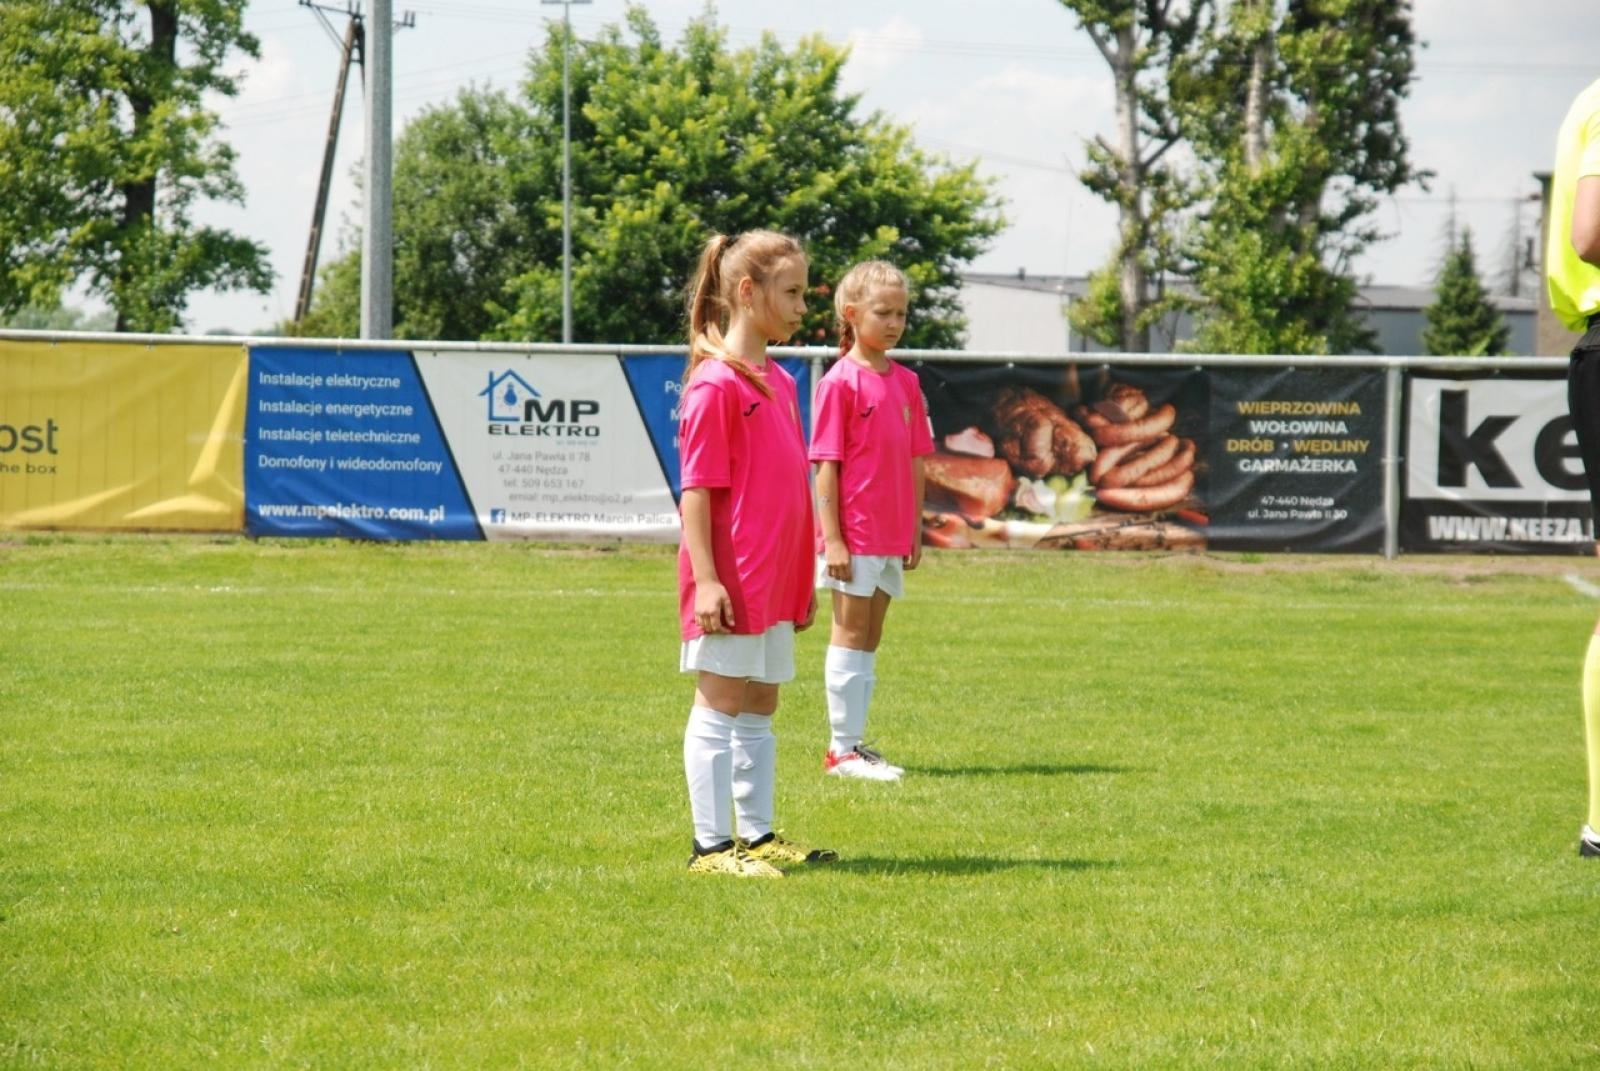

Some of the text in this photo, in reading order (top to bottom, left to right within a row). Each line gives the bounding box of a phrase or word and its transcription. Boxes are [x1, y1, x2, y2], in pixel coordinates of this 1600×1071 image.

[259, 371, 401, 390] Instalacje elektryczne
[259, 399, 413, 418] Instalacje energetyczne
[524, 399, 600, 423] MP
[1237, 401, 1361, 415] WIEPRZOWINA
[488, 424, 600, 437] ELEKTRO
[1250, 420, 1349, 434] WOŁOWINA
[259, 428, 421, 444] Instalacje teletechniczne
[1226, 436, 1370, 455] DRÓB WĘDLINY
[507, 451, 532, 461] Jana
[26, 461, 57, 474] box
[258, 454, 443, 474] Domofony i wideodomofony
[498, 464, 533, 474] 47-440
[1238, 456, 1358, 473] GARMAŻERKA
[522, 479, 540, 488] 509
[1260, 495, 1298, 506] 47-440
[258, 502, 445, 523] www.mpelektro.com.pl
[595, 513, 634, 524] Marcin
[638, 513, 673, 524] Palica
[1247, 509, 1260, 519] ul.
[1262, 509, 1289, 519] Jana
